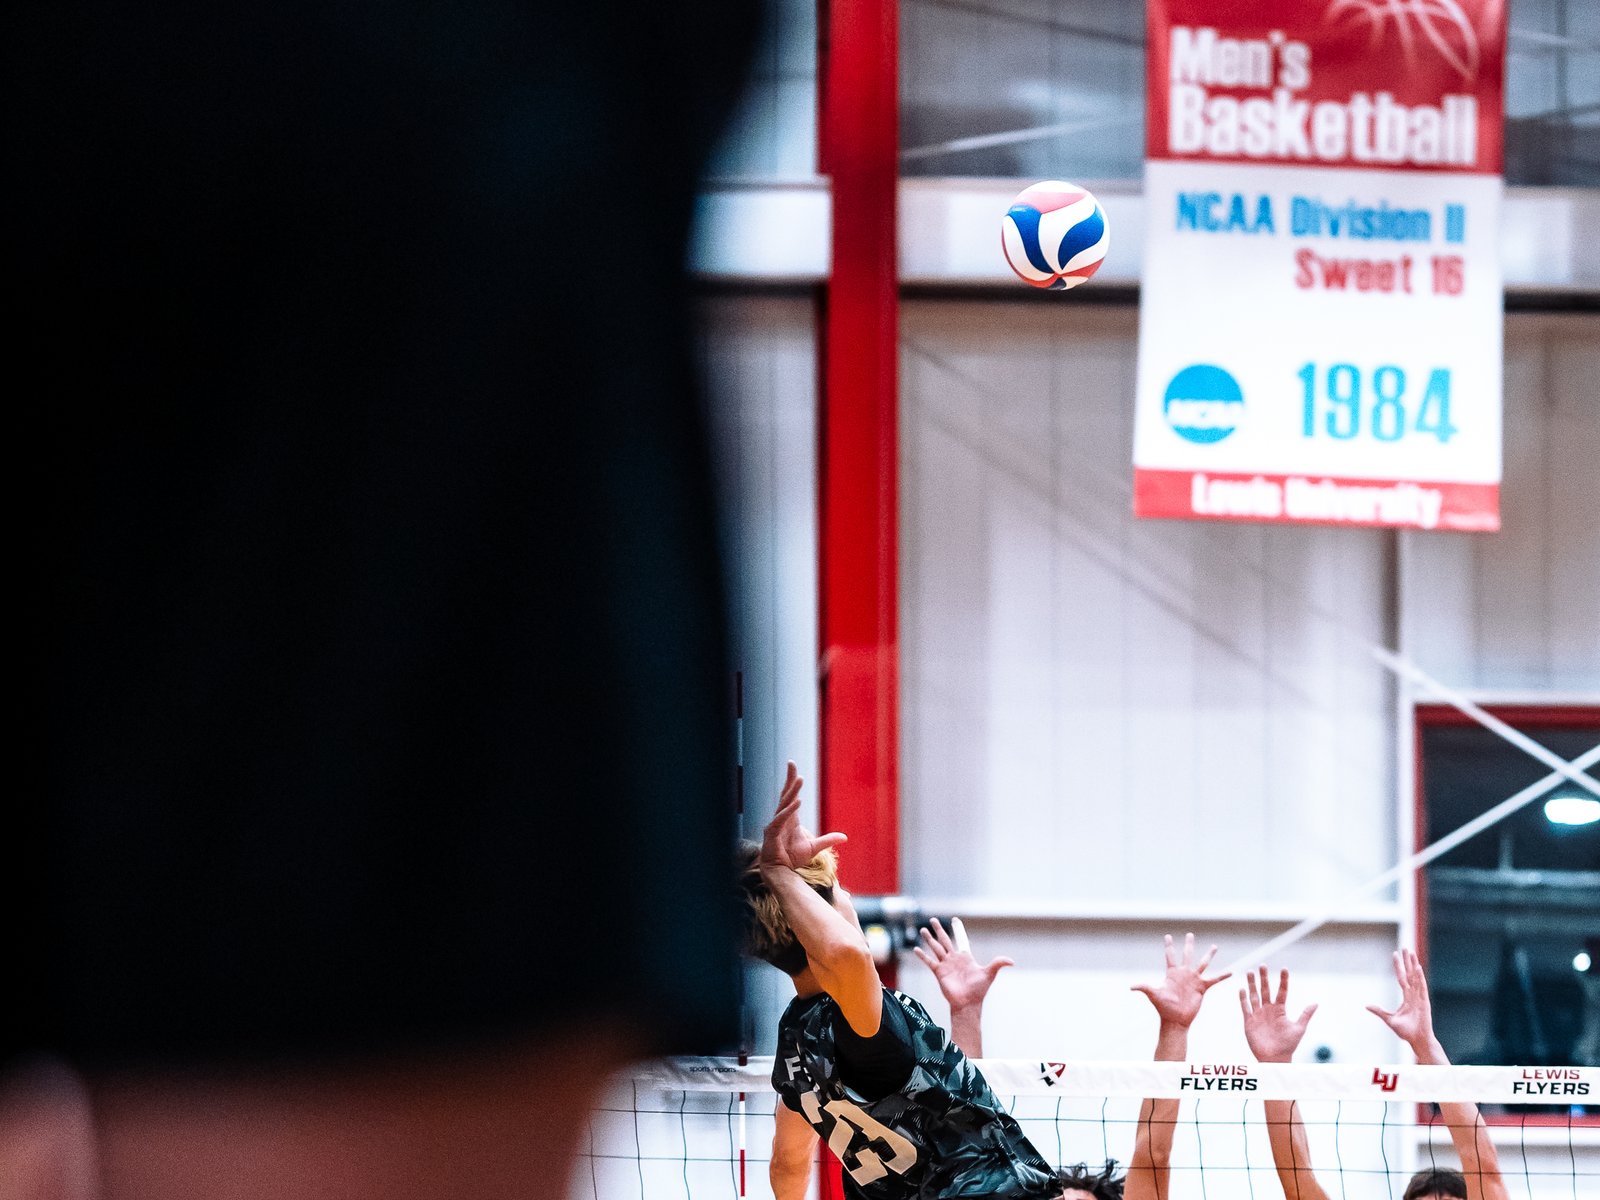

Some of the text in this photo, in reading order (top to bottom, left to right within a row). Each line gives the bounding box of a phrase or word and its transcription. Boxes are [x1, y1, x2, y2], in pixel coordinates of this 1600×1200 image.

[1171, 27, 1311, 89] Men's
[1170, 85, 1477, 166] Basketball
[1176, 191, 1466, 244] NCAA Division II
[1294, 247, 1465, 297] Sweet 16
[1297, 361, 1459, 444] 1984
[1180, 1077, 1258, 1091] FLYERS
[1190, 1064, 1248, 1076] LEWIS
[1372, 1068, 1399, 1092] LU
[1513, 1081, 1590, 1095] FLYERS
[1522, 1068, 1580, 1080] LEWIS
